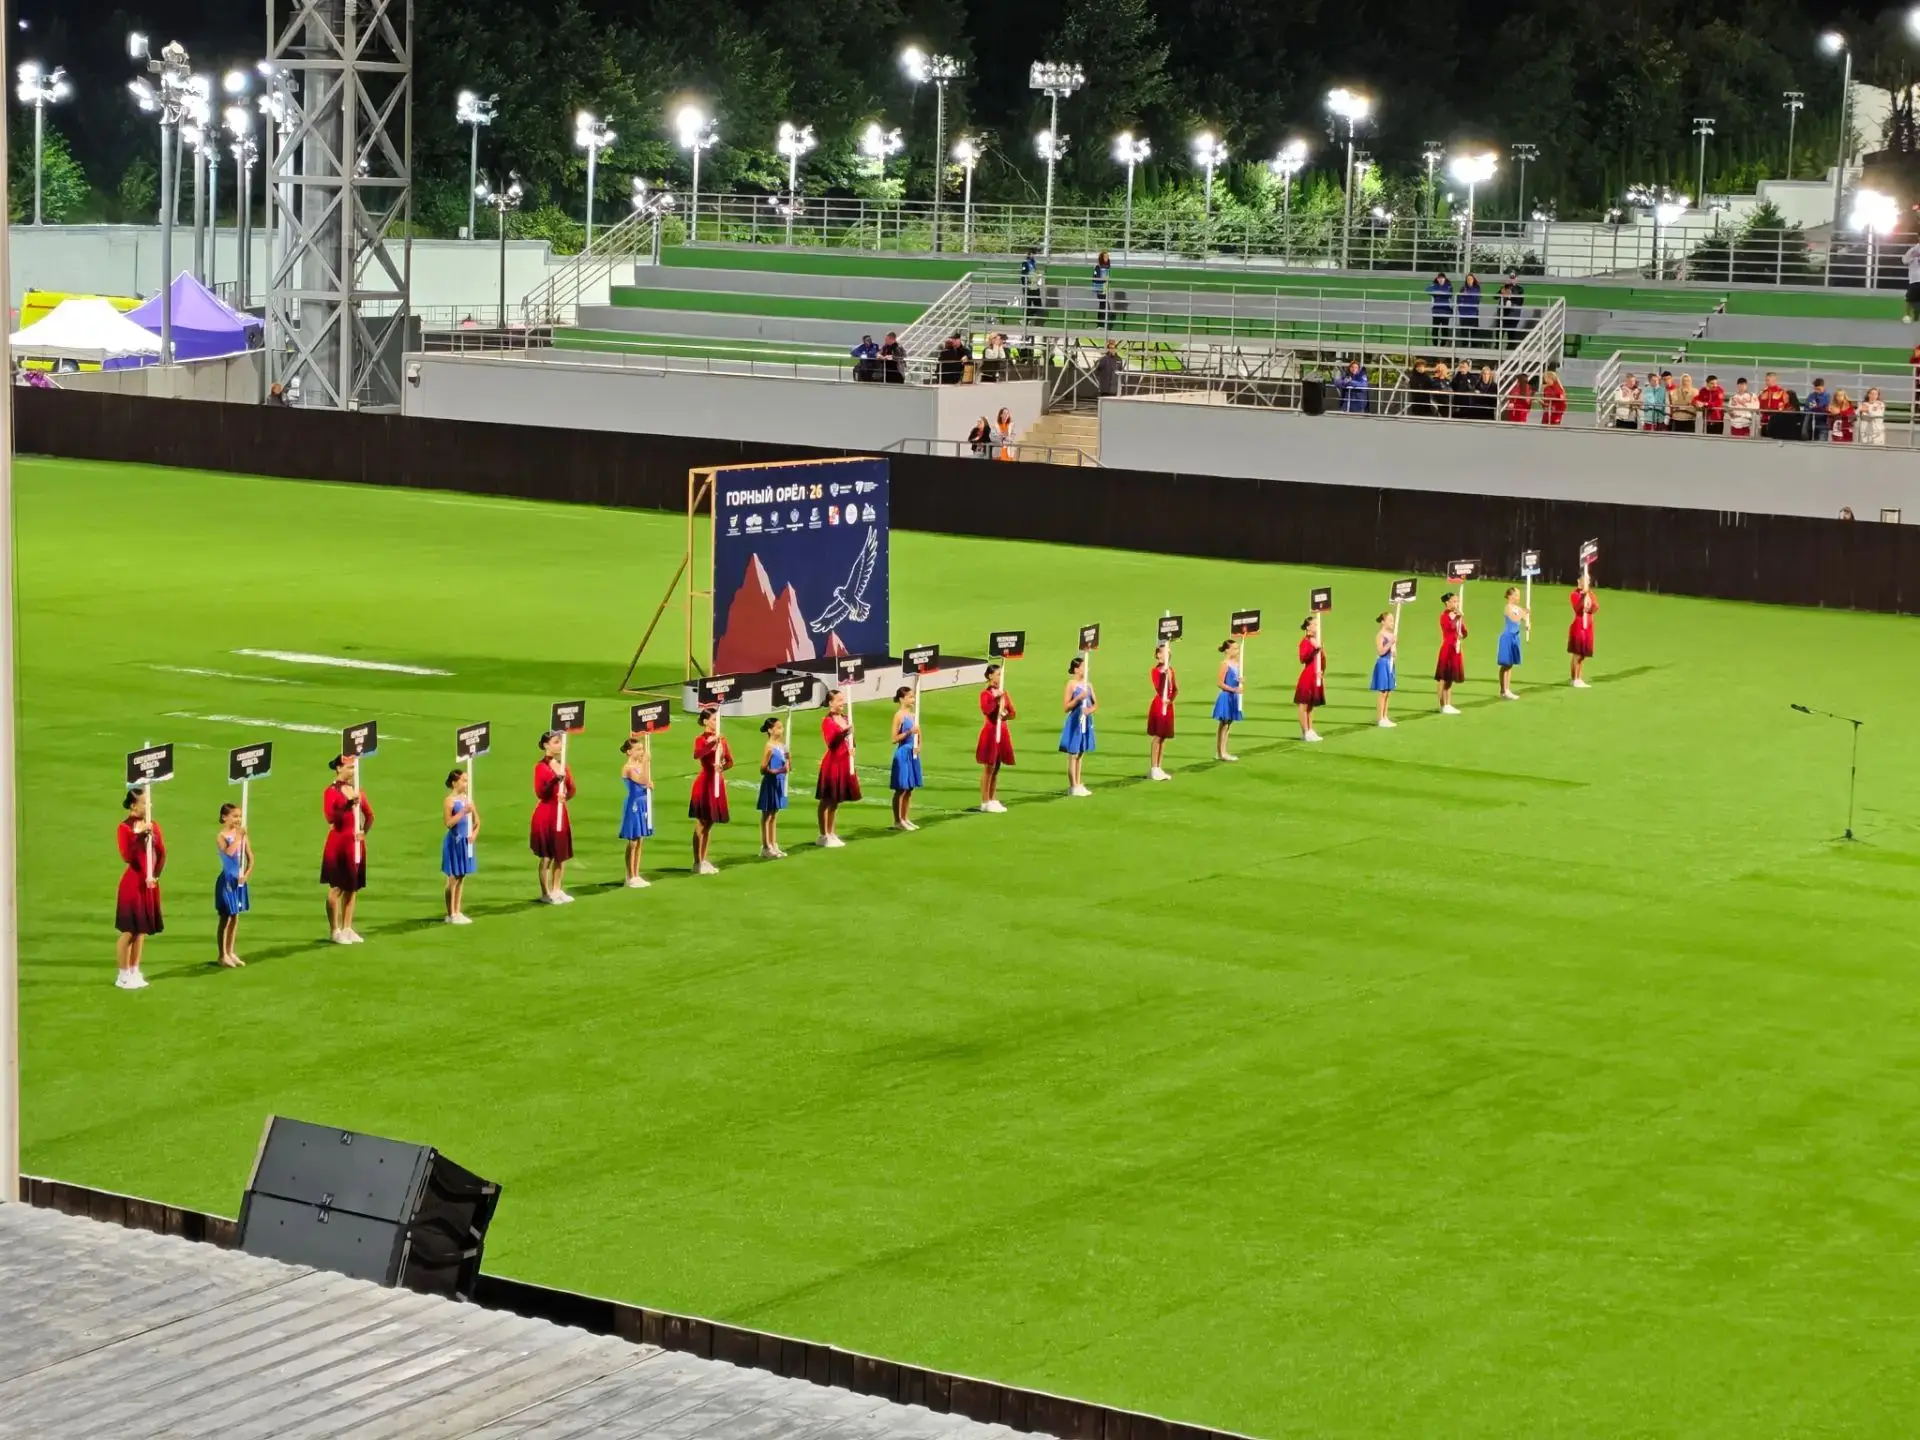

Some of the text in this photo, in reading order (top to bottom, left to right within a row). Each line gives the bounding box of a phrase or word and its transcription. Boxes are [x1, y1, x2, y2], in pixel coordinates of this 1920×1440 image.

[726, 485, 773, 506] ГОРНЫЙ
[776, 483, 806, 502] ОРЁЛ
[809, 484, 823, 499] 26
